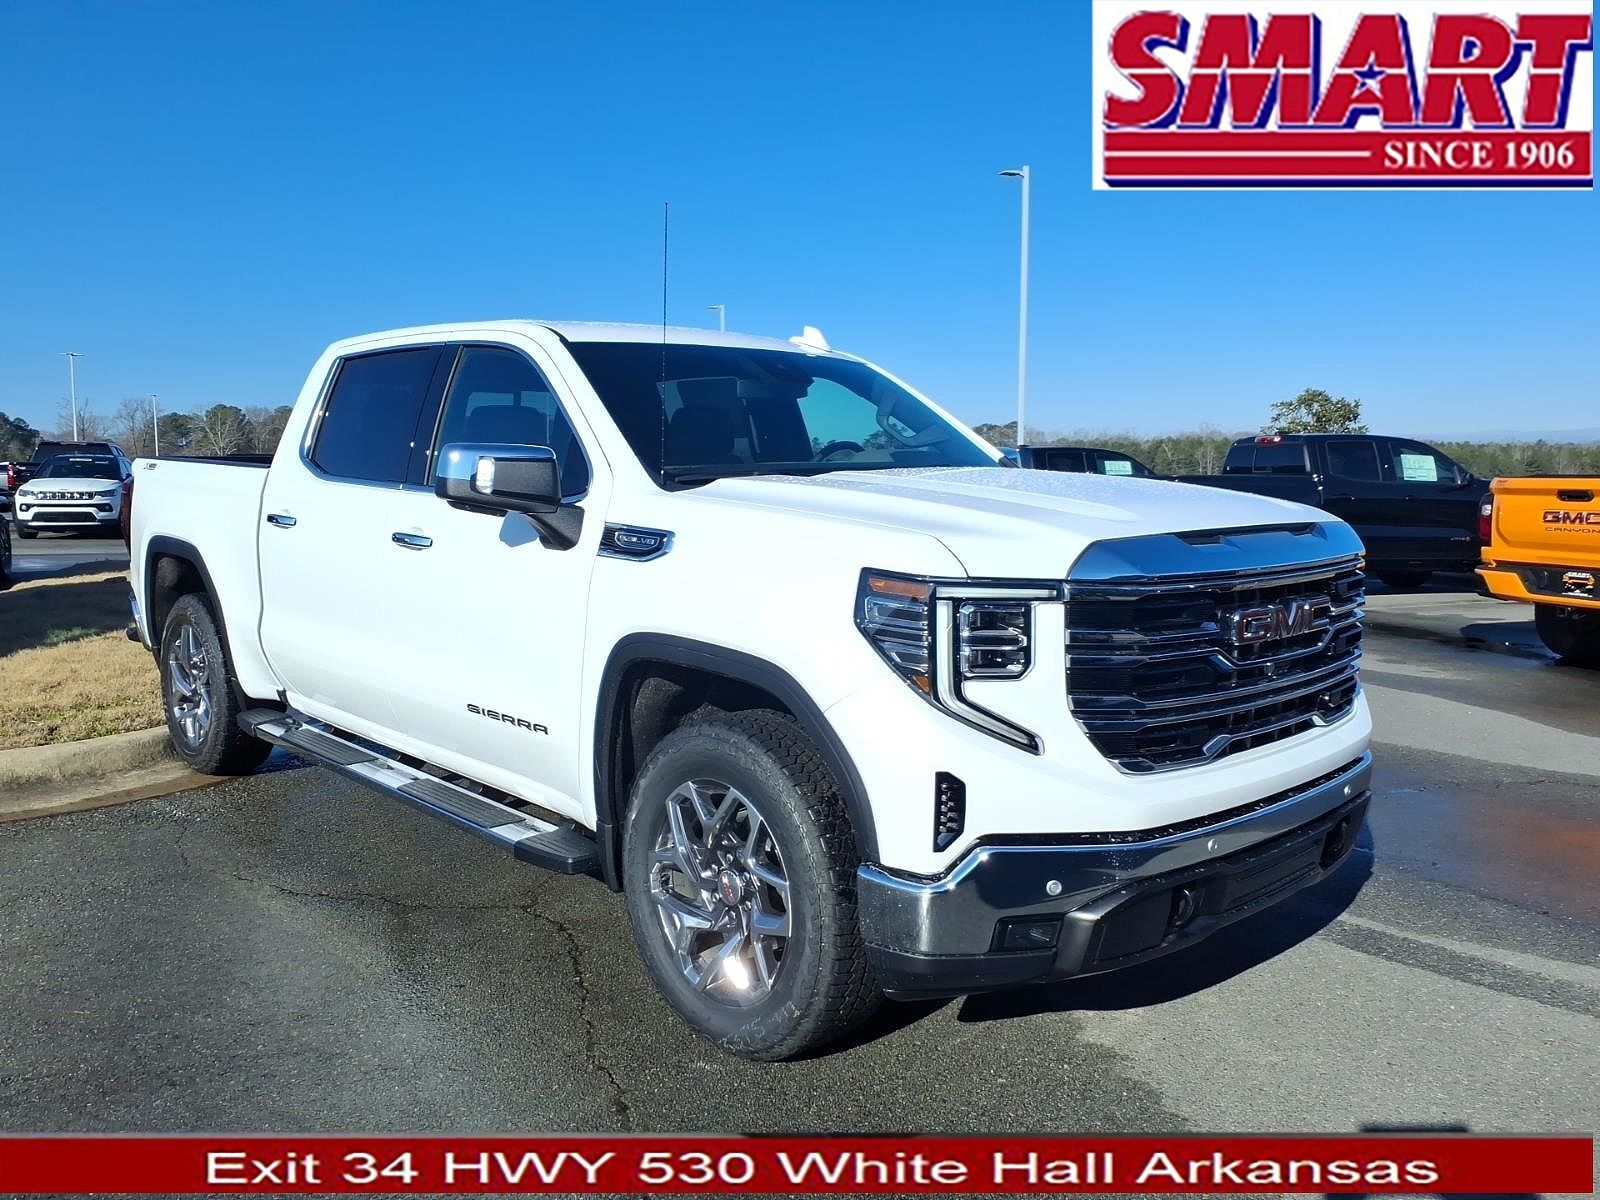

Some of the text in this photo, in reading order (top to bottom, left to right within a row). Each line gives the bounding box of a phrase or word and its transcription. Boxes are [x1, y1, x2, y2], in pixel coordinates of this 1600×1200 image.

[1543, 511, 1600, 524] GMC
[1234, 597, 1332, 645] GMC
[466, 703, 549, 735] SIERRA
